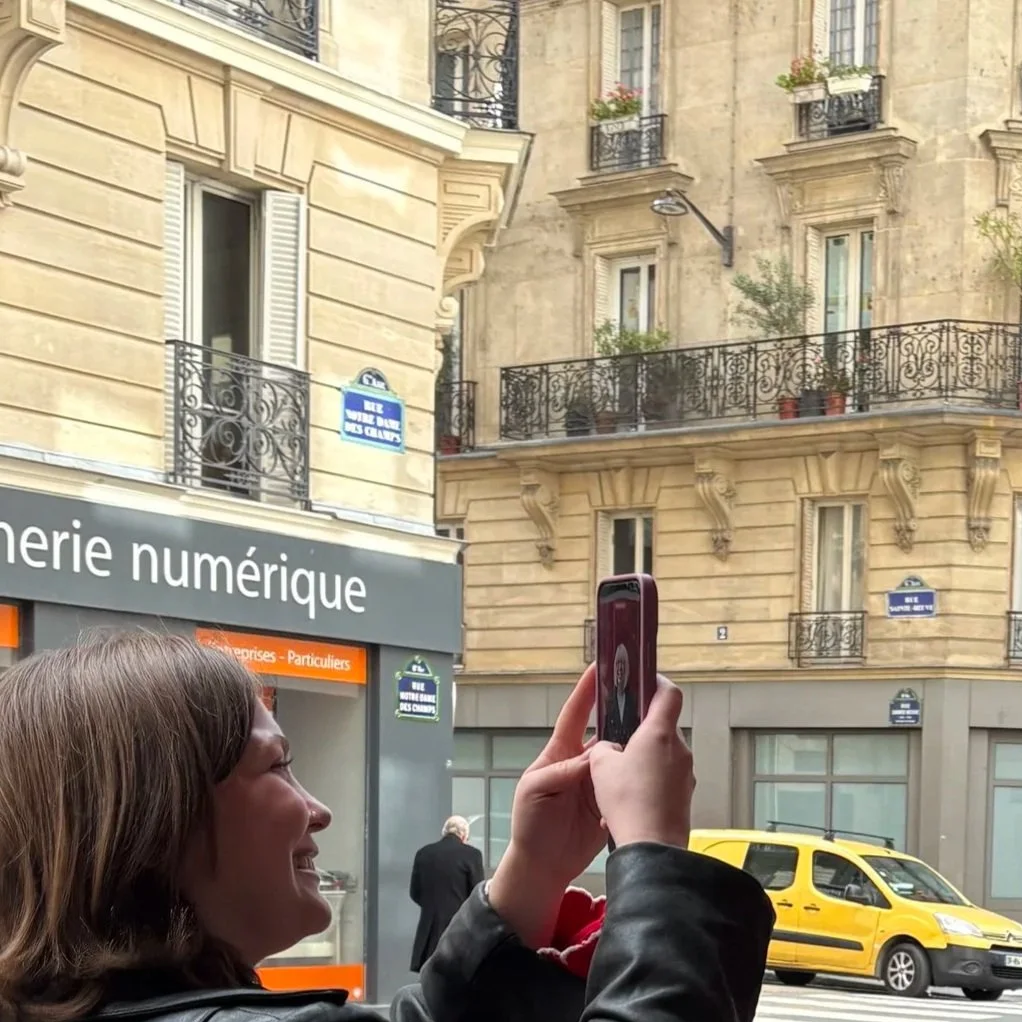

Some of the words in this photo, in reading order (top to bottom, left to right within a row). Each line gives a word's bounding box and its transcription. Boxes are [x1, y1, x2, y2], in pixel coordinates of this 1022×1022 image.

[363, 400, 384, 414] RUE
[345, 409, 375, 425] NOTRE
[376, 415, 401, 430] DAME
[344, 421, 363, 435] DES
[364, 426, 401, 443] CHAMPS
[132, 542, 367, 620] numérique
[288, 649, 351, 672] Particuliers
[412, 681, 425, 691] RUE
[400, 691, 419, 701] NOTRE
[419, 693, 436, 703] DAME
[400, 702, 411, 712] DES
[412, 703, 436, 714] CHAMPS
